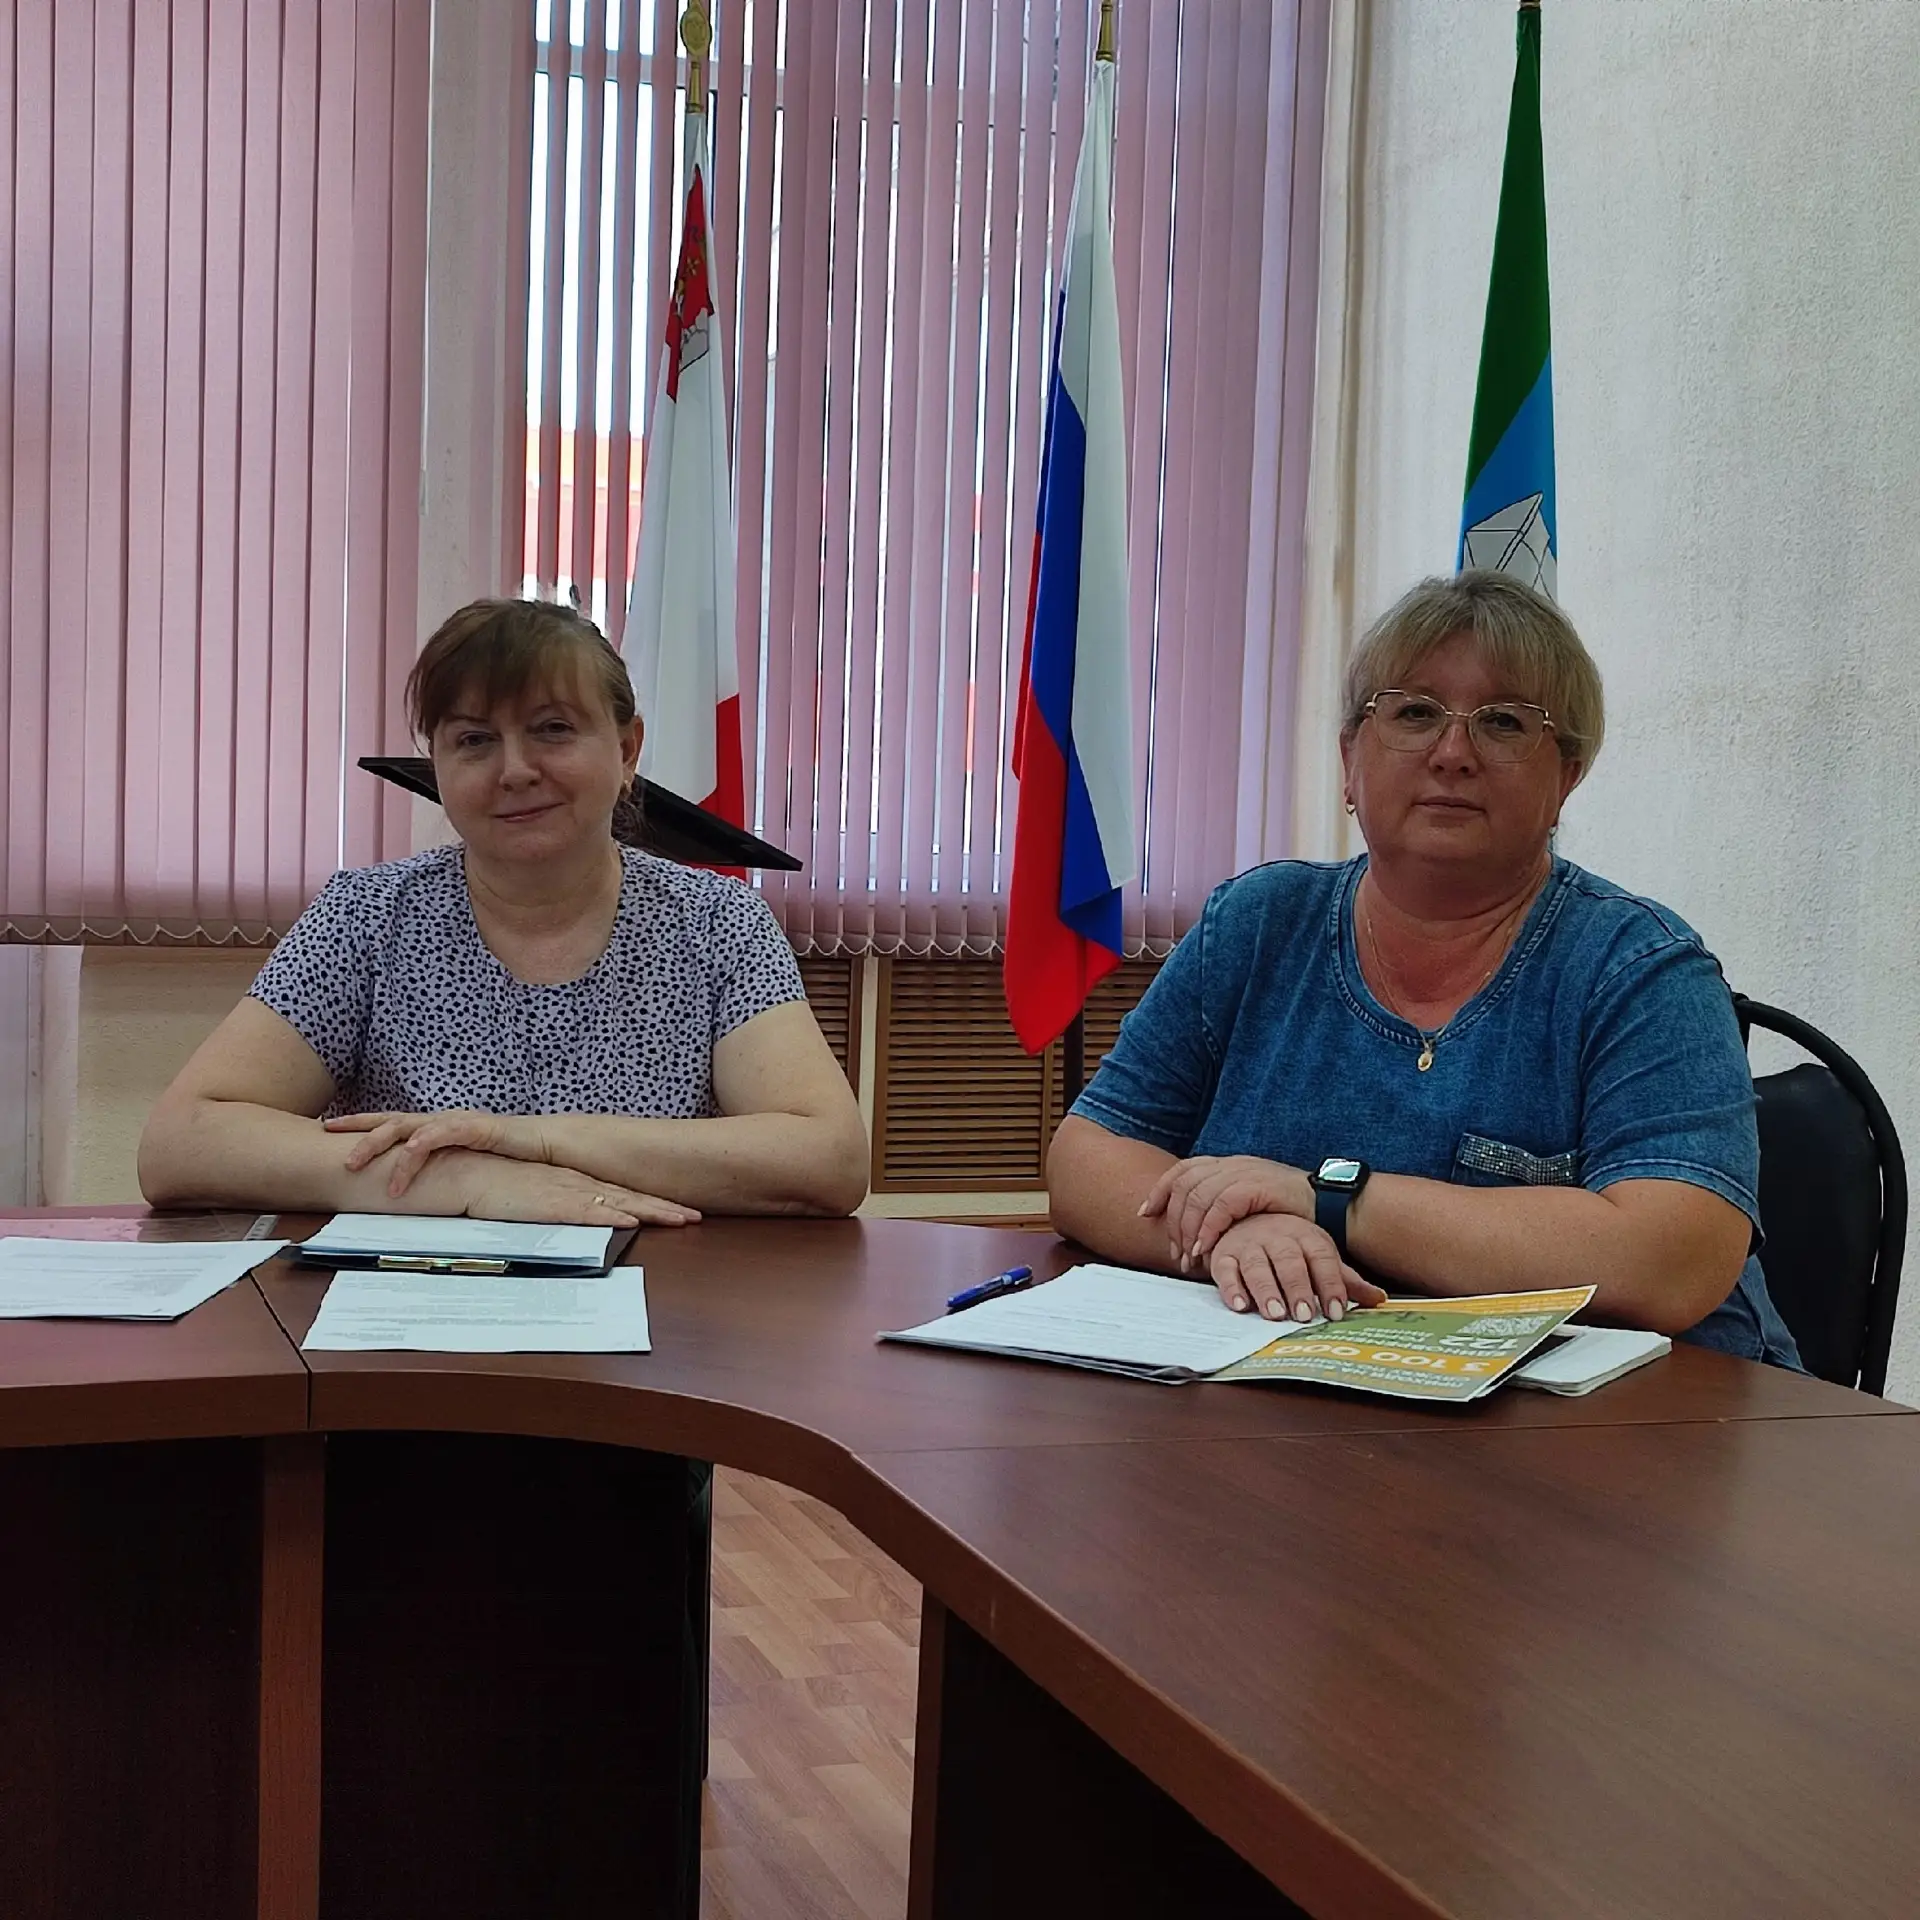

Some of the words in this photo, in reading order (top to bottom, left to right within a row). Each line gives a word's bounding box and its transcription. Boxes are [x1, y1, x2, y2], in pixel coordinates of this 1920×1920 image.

[1439, 1335, 1518, 1349] 122
[1274, 1345, 1361, 1356] 000
[1372, 1352, 1446, 1368] 100
[1461, 1362, 1490, 1372] 3
